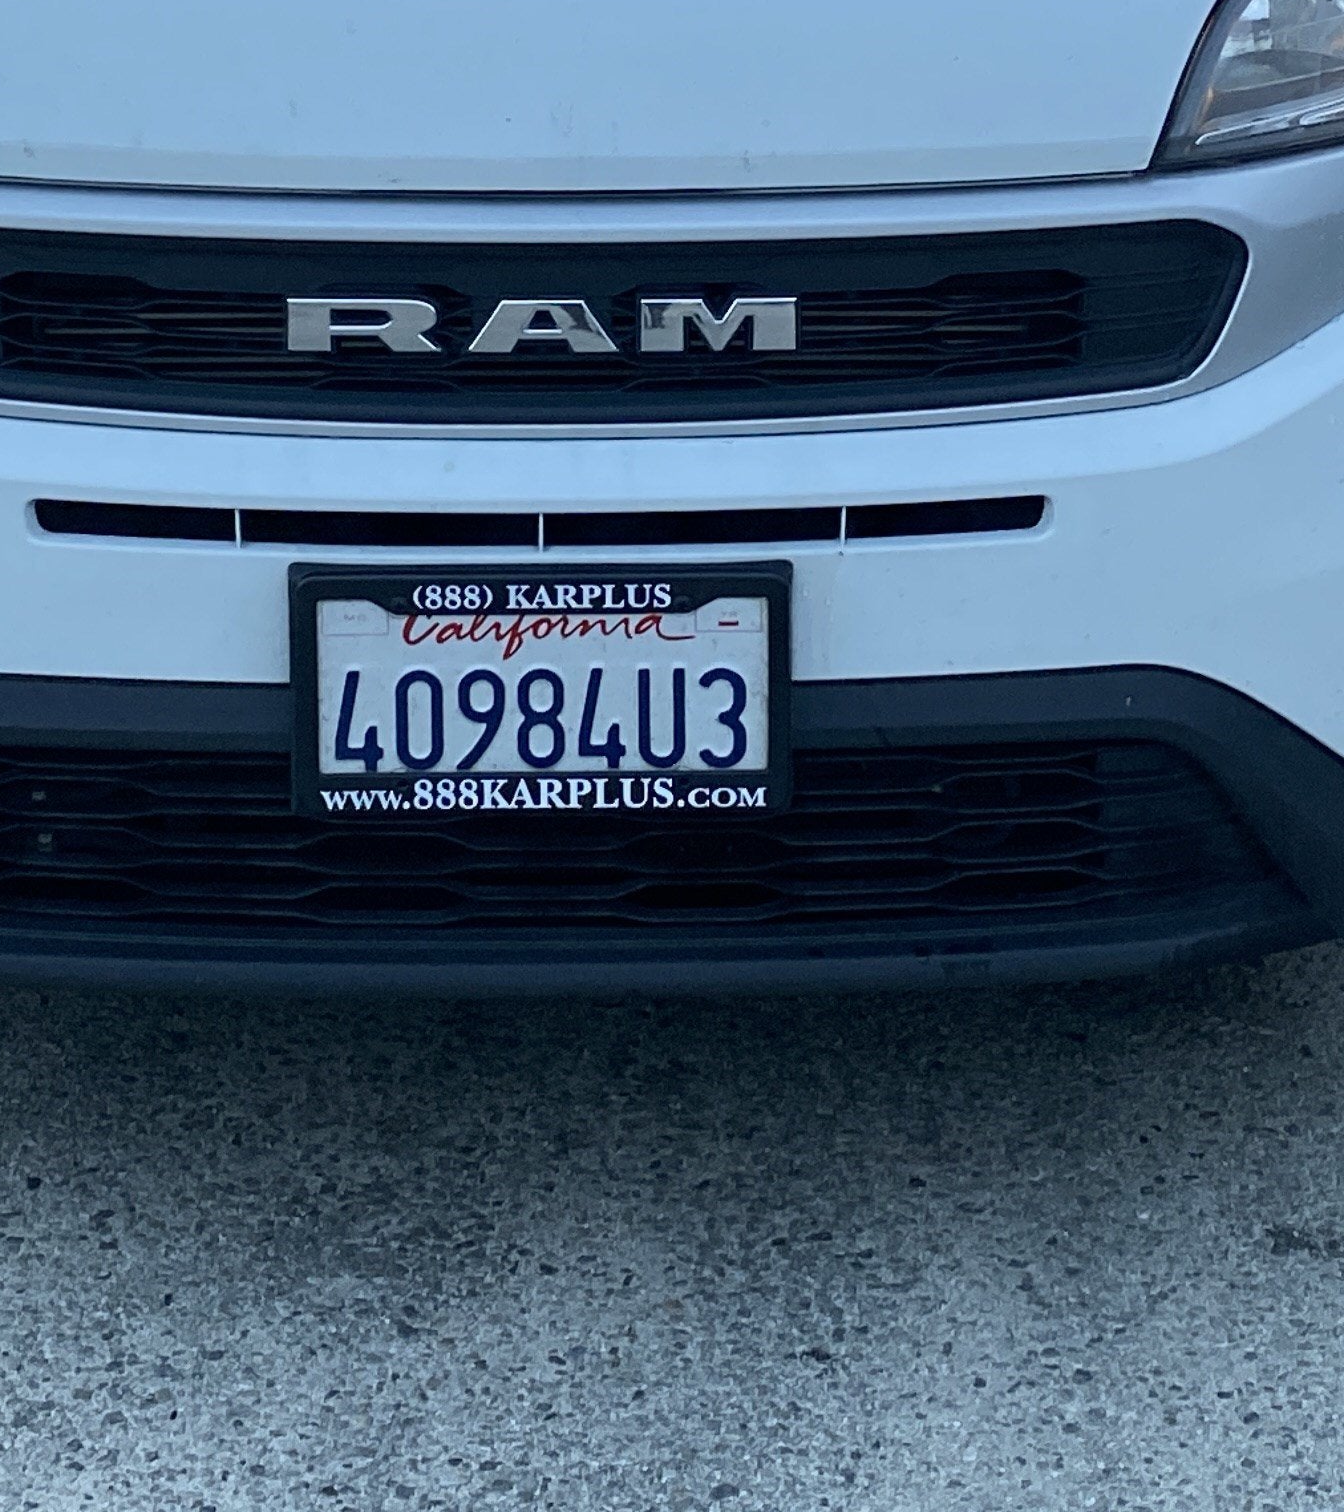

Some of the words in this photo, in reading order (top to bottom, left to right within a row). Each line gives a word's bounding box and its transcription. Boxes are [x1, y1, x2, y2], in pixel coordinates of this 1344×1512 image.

[286, 296, 798, 353] RAM
[412, 584, 493, 611] (888)
[505, 583, 672, 610] KARPLUS
[402, 612, 696, 661] California
[334, 667, 749, 773] 40984U3
